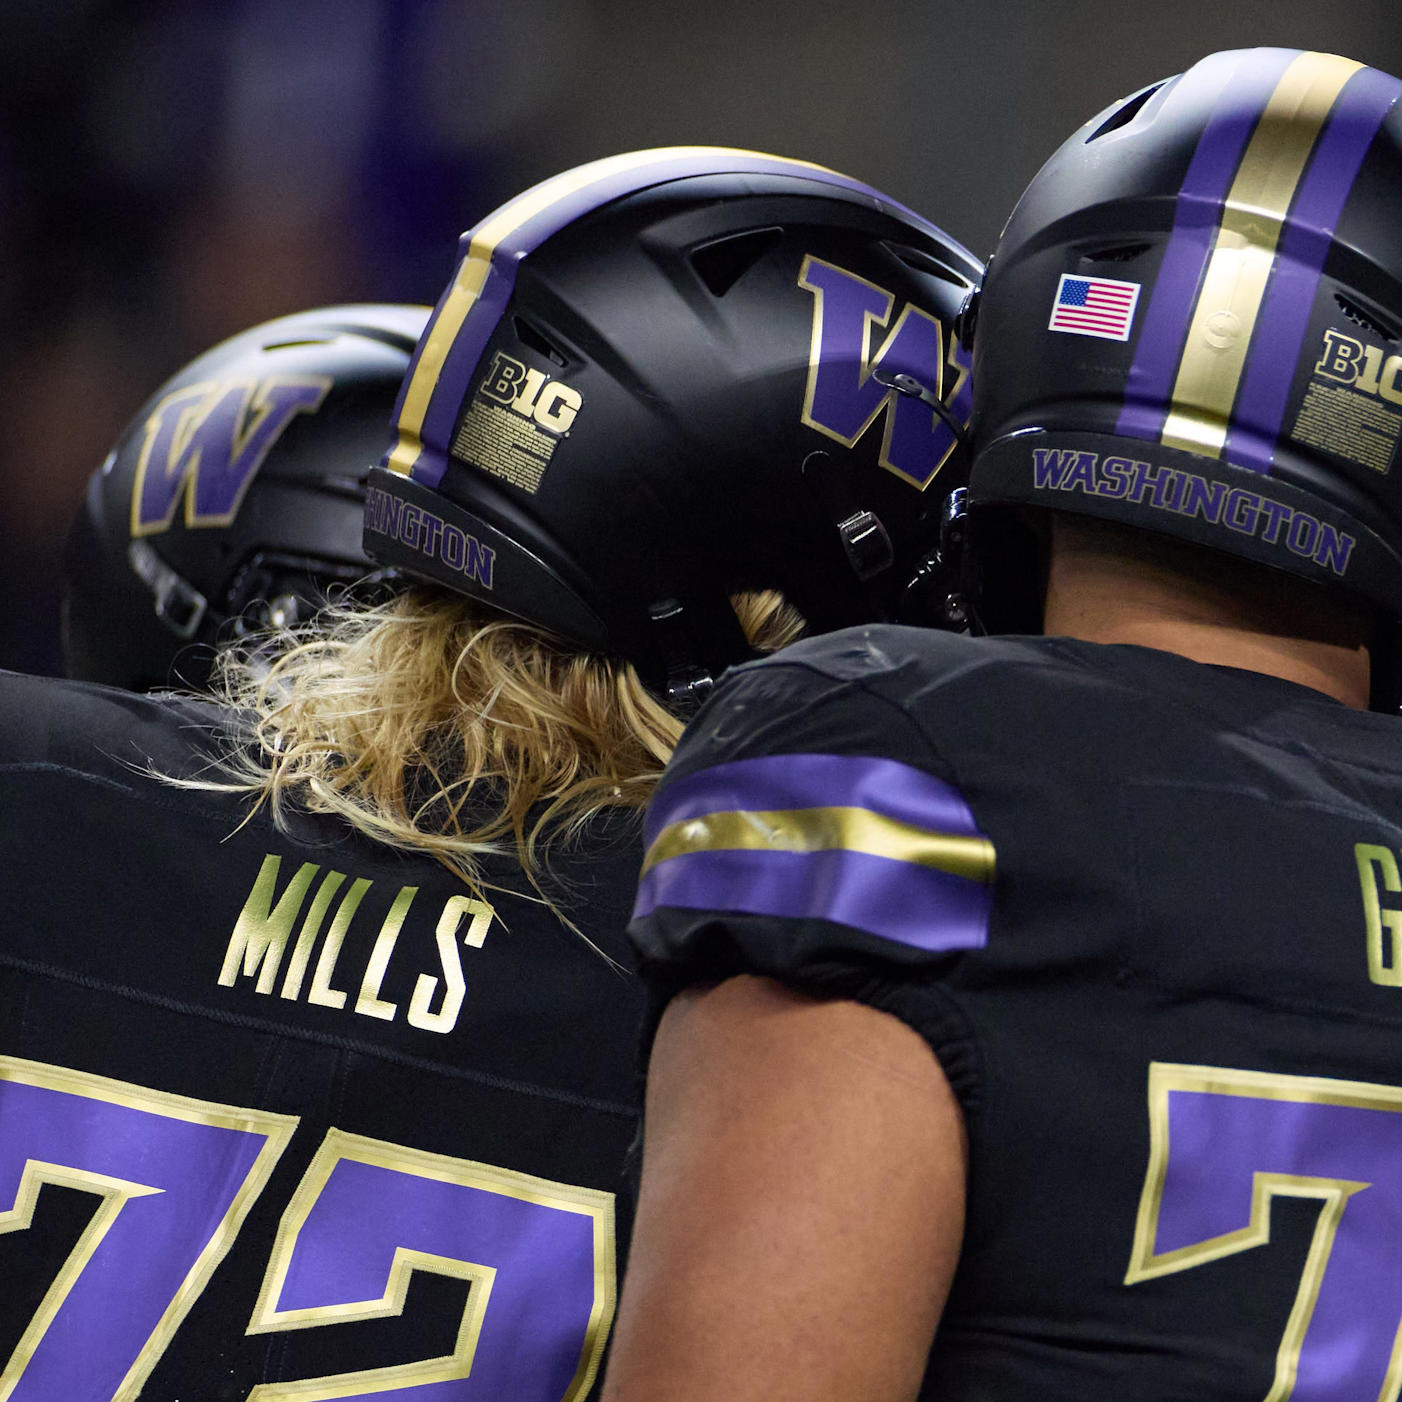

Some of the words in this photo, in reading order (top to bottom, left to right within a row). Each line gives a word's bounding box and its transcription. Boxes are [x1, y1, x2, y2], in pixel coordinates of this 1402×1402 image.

[130, 376, 334, 538] W
[800, 255, 974, 492] W
[1032, 448, 1356, 576] WASHINGTON
[217, 853, 495, 1035] MILLS
